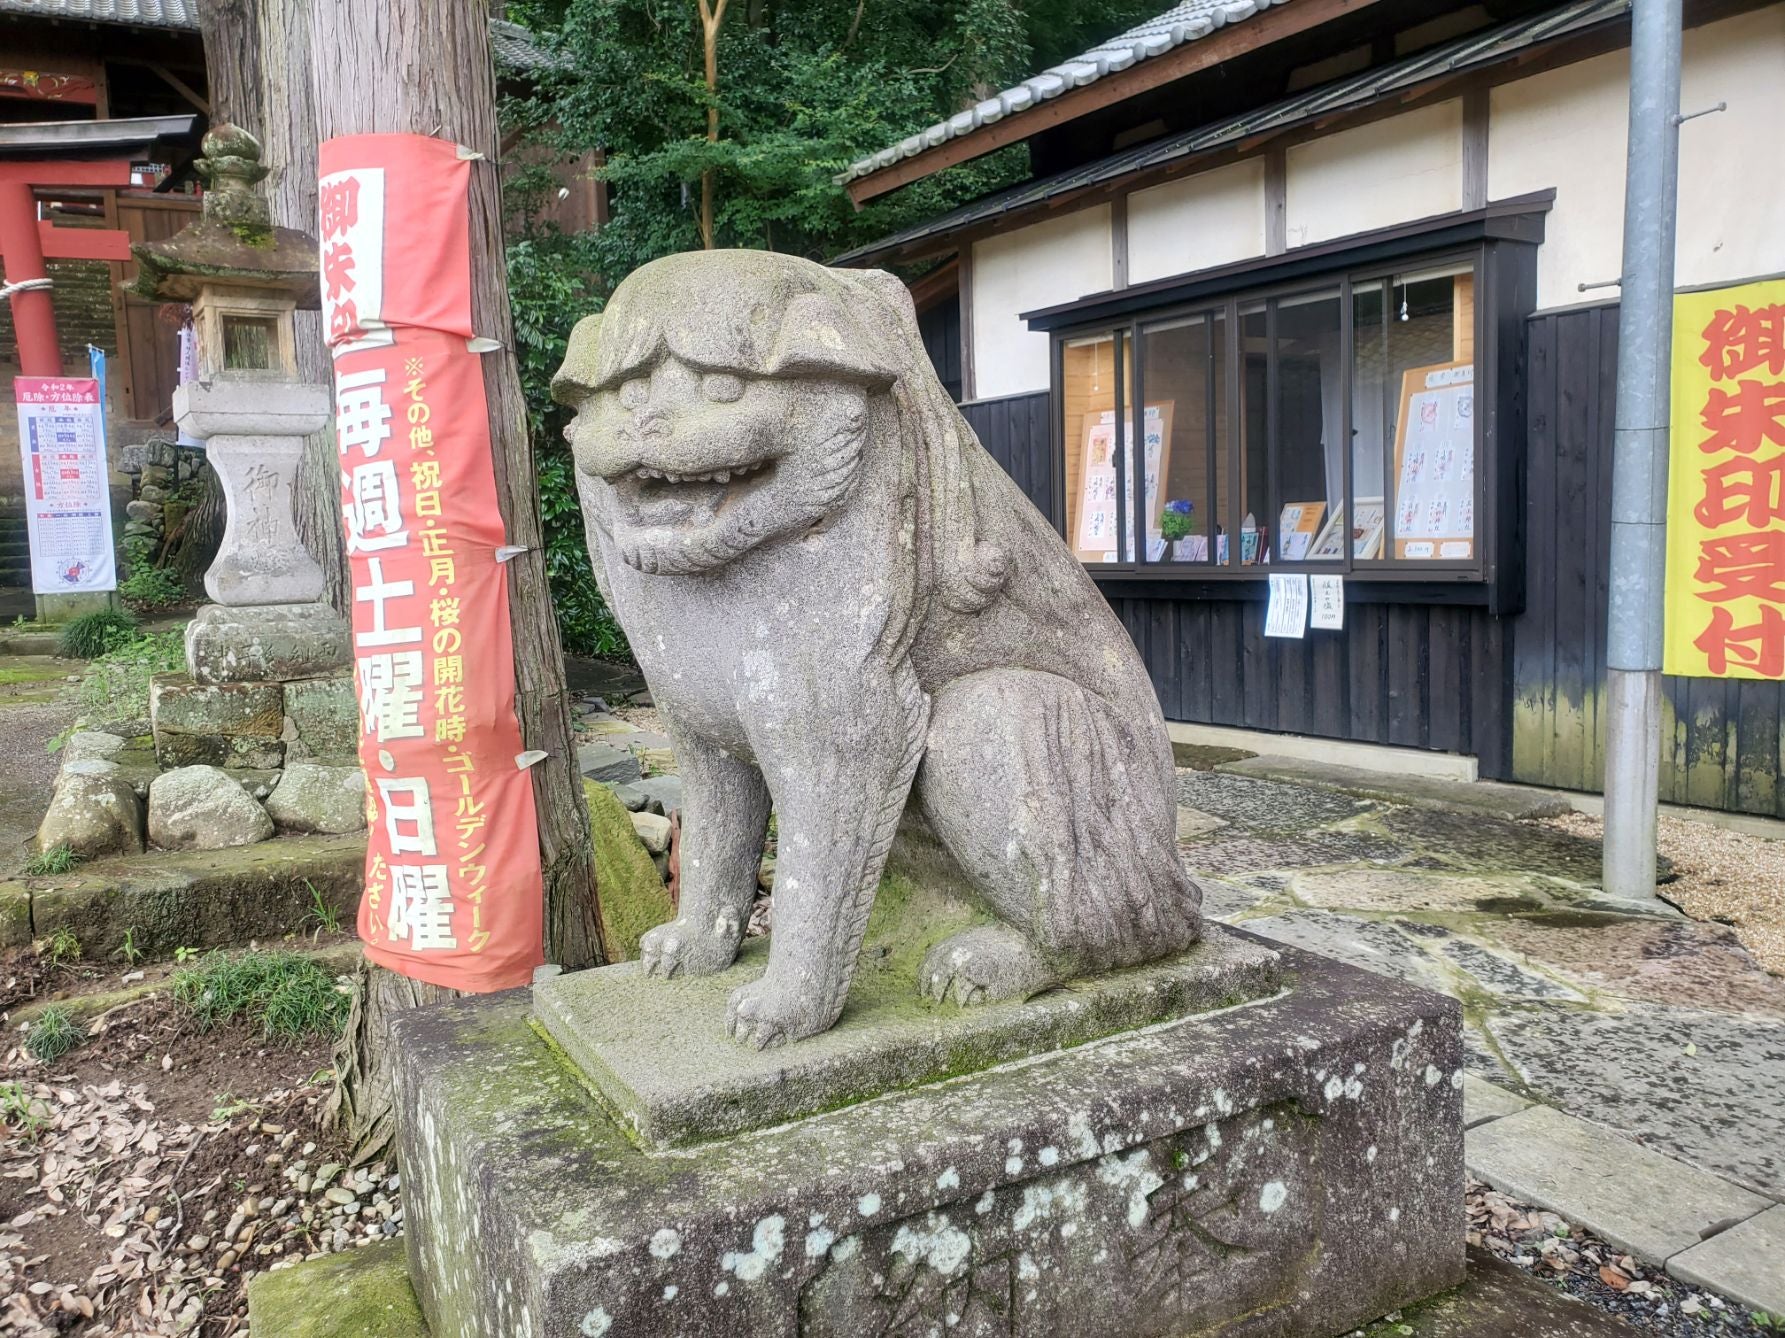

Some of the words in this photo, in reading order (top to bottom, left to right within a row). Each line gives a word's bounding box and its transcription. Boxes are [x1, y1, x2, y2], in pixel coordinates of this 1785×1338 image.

[41, 383, 74, 391] 令和2年
[1692, 302, 1785, 678] 御朱印受付
[243, 464, 290, 572] 御神
[335, 367, 458, 952] 毎週土曜・日曜
